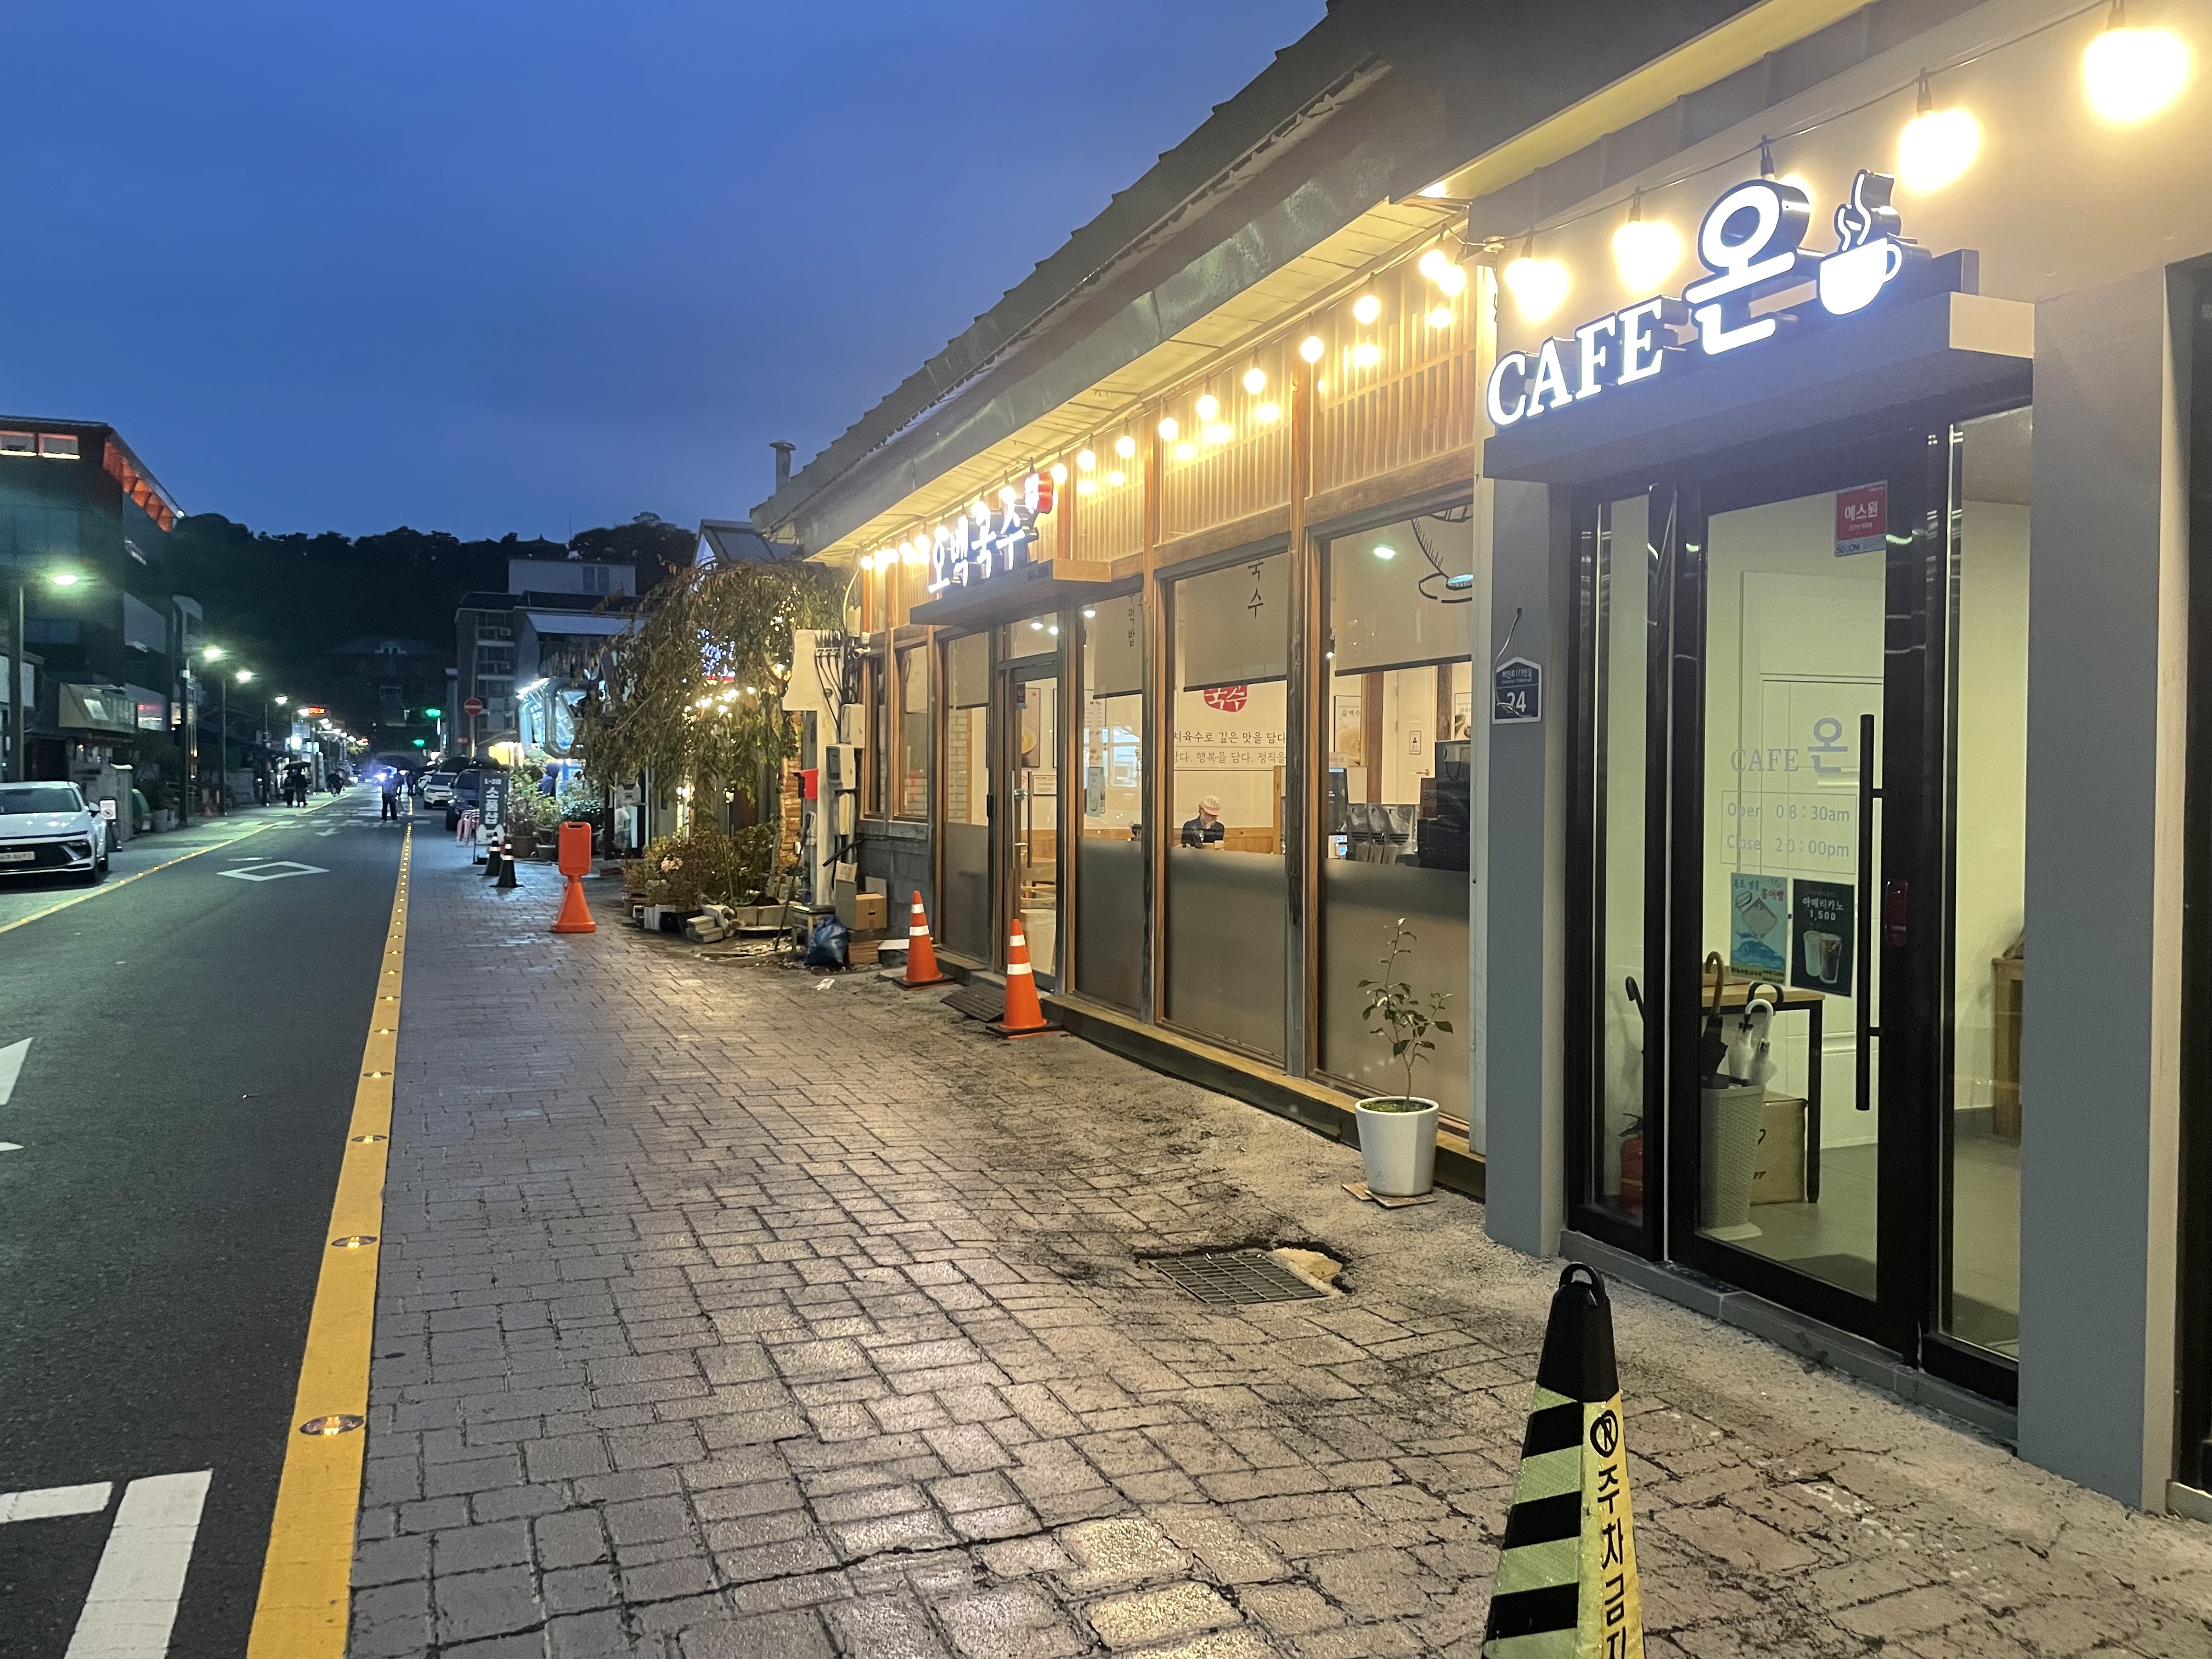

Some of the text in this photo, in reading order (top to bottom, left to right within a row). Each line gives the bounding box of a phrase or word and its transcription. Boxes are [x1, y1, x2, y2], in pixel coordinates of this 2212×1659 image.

[1486, 184, 1797, 426] CAFE 온
[1844, 500, 1878, 521] 에스원
[928, 495, 1026, 594] 오백국수
[1506, 691, 1527, 713] 24
[1218, 731, 1239, 744] 깊은
[1243, 731, 1263, 744] 맛을
[1267, 732, 1287, 744] 담다
[1730, 717, 1848, 772] CAFE 온
[1197, 751, 1227, 764] 행복을
[1231, 752, 1254, 764] 담다.
[1257, 752, 1286, 764] 정직을
[1728, 802, 1850, 822] Open 08:30am
[1726, 834, 1850, 860] Close 20:00pm
[1802, 896, 1844, 911] 아메리카노
[1810, 909, 1836, 921] 1,500
[1597, 1464, 1627, 1659] 주차금지
